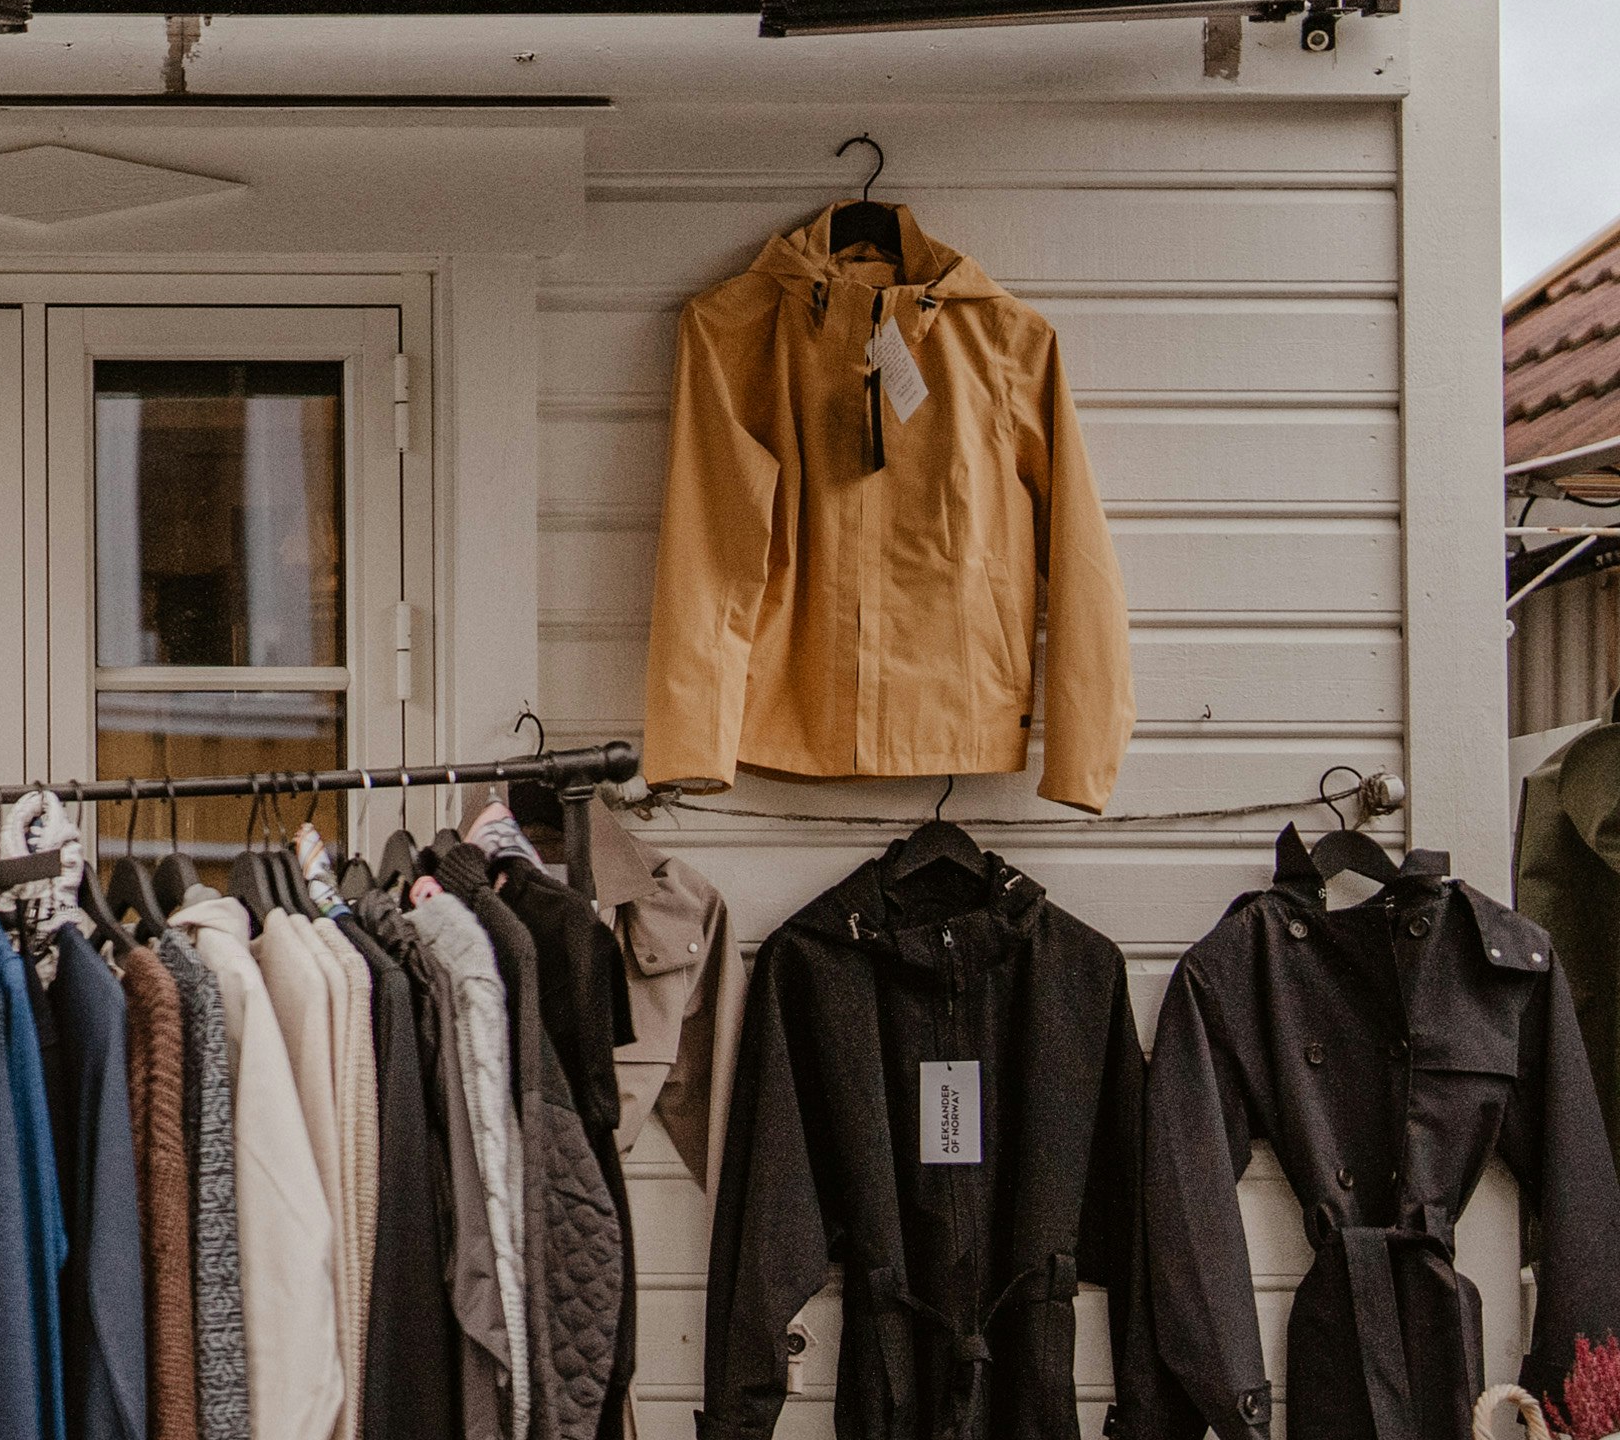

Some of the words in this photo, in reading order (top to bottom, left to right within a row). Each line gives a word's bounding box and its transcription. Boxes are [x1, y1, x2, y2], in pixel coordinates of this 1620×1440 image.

[941, 1084, 950, 1154] ALEKSANDER
[951, 1090, 960, 1136] NORWAY
[951, 1139, 960, 1154] OF
